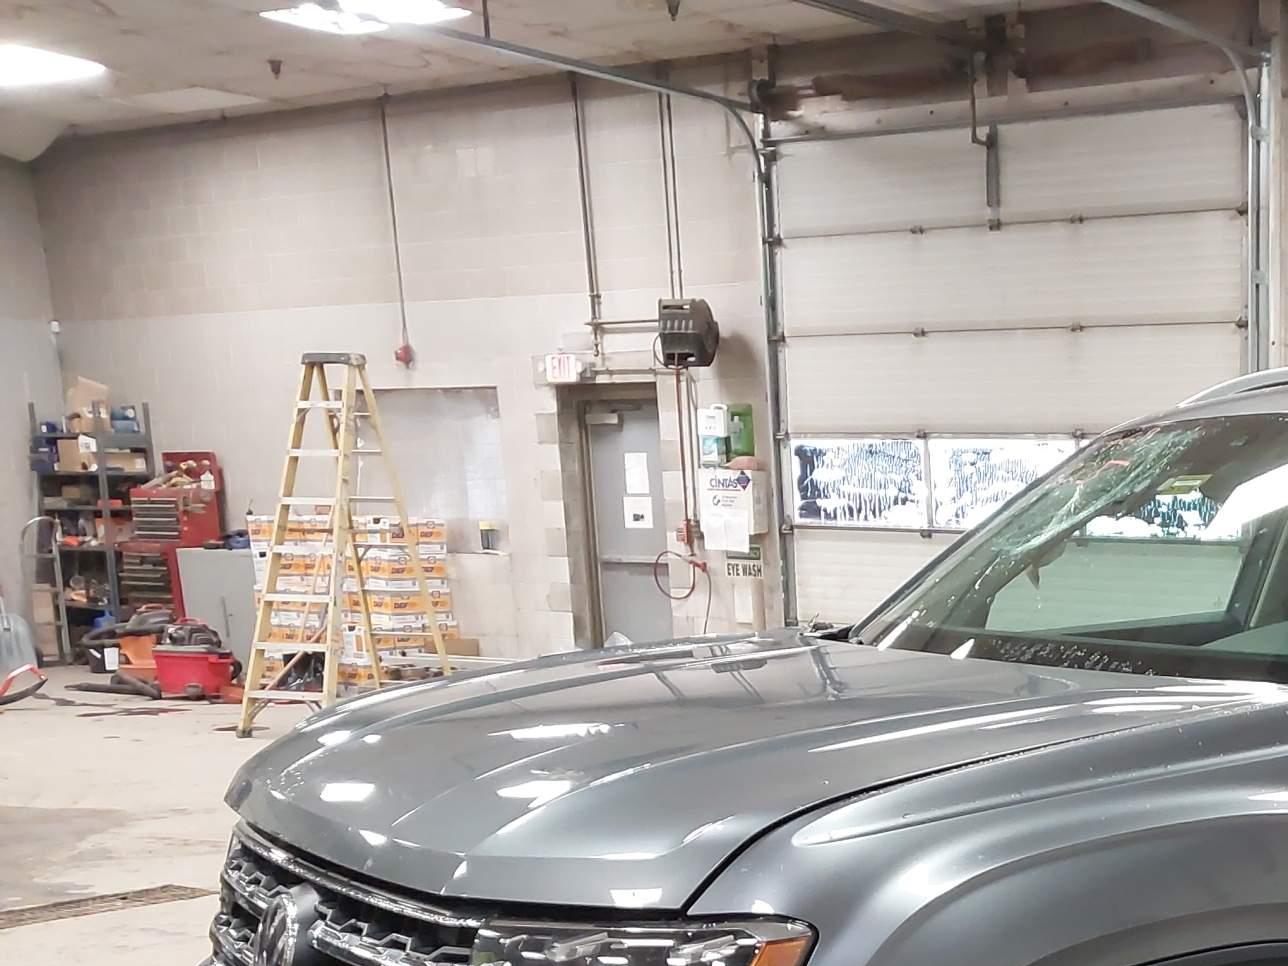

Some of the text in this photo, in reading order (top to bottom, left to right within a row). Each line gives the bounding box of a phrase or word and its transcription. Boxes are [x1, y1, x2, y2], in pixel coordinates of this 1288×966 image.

[551, 355, 571, 379] EXIT
[709, 475, 738, 489] CINTAS
[391, 566, 406, 574] DEF
[726, 563, 762, 578] EYE WASH
[393, 601, 409, 609] DEF
